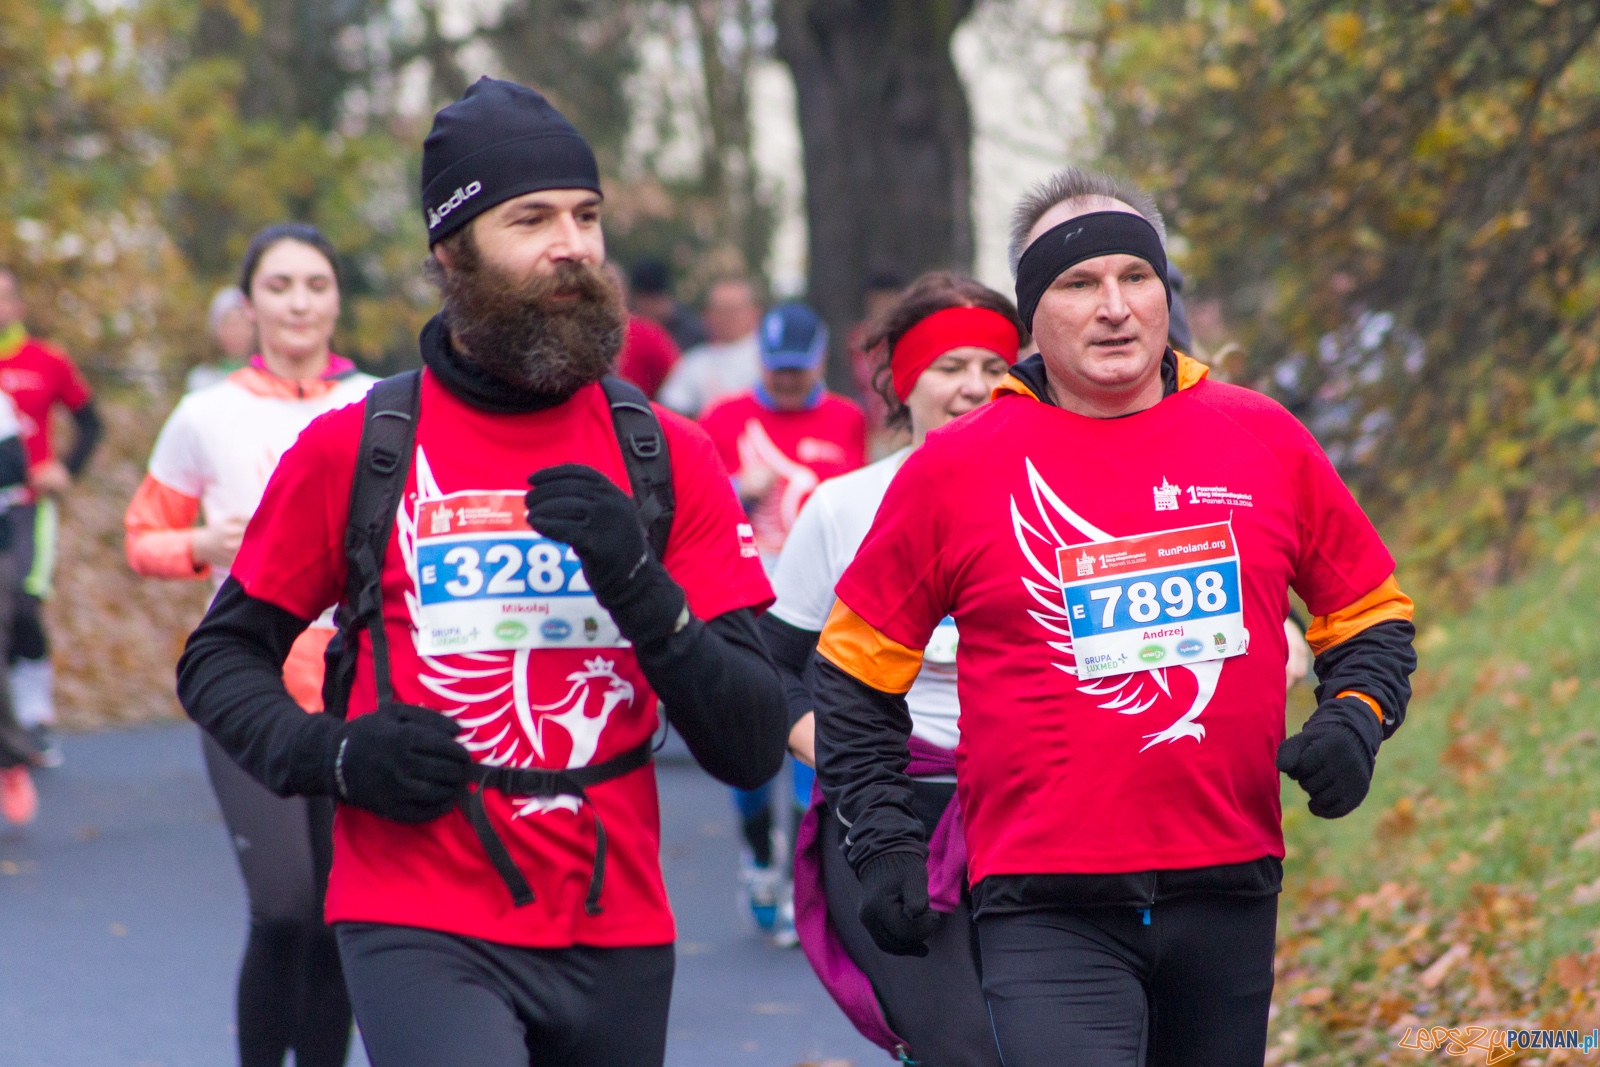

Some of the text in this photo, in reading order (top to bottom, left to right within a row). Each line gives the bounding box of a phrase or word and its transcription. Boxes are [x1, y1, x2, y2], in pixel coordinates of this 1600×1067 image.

[437, 181, 482, 218] odlo
[1186, 485, 1200, 504] 1
[1158, 540, 1226, 557] RunPoland.org
[1098, 554, 1108, 569] 1
[421, 565, 437, 585] E
[1072, 570, 1227, 629] E 7898
[502, 603, 550, 615] Mikołaj
[1142, 626, 1184, 641] Andrzej
[1085, 654, 1112, 665] GRUPA
[1086, 662, 1119, 673] LUXMED
